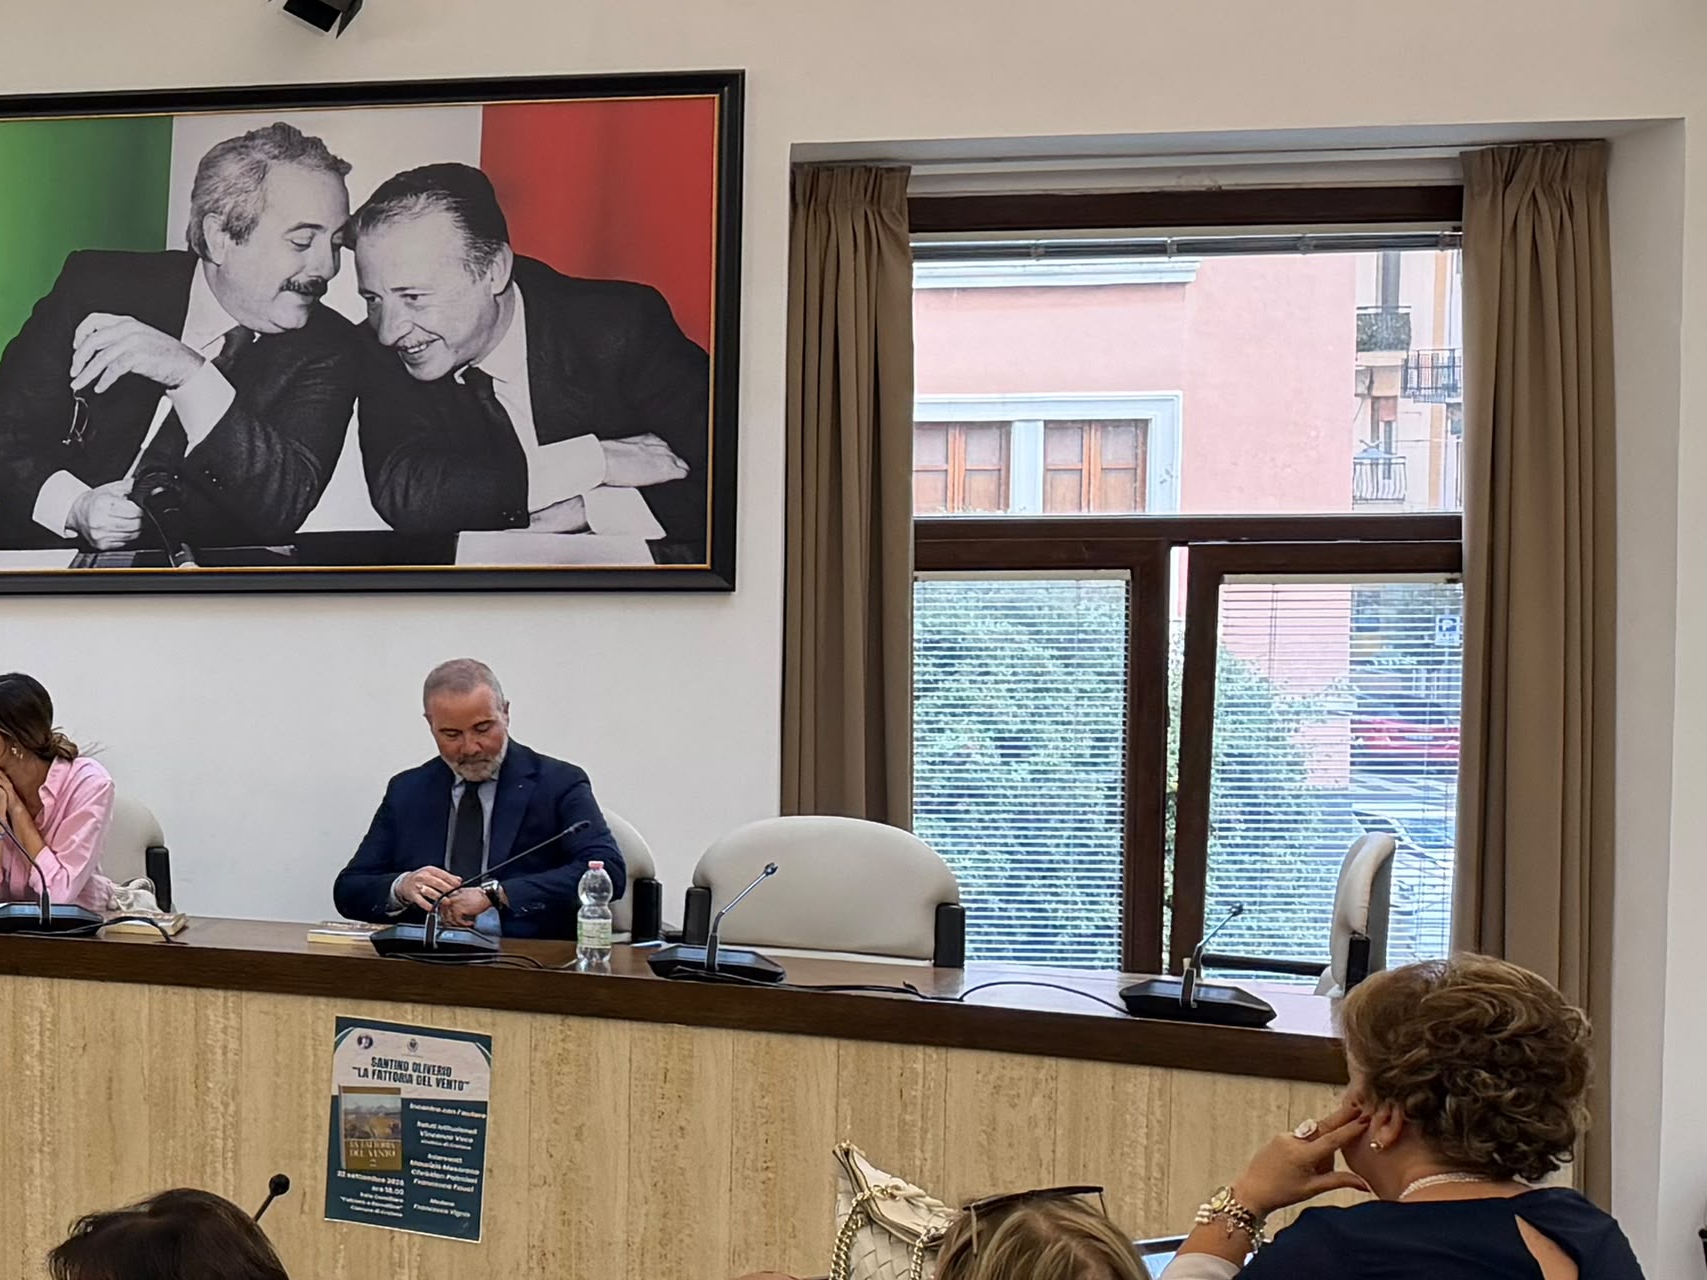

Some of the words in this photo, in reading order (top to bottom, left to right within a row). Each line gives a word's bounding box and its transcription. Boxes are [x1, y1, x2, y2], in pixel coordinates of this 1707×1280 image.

[371, 1056, 409, 1071] SANTINO
[411, 1061, 453, 1078] OLIVERIO
[371, 1069, 414, 1084] FATTORIA
[416, 1074, 433, 1088] DEL
